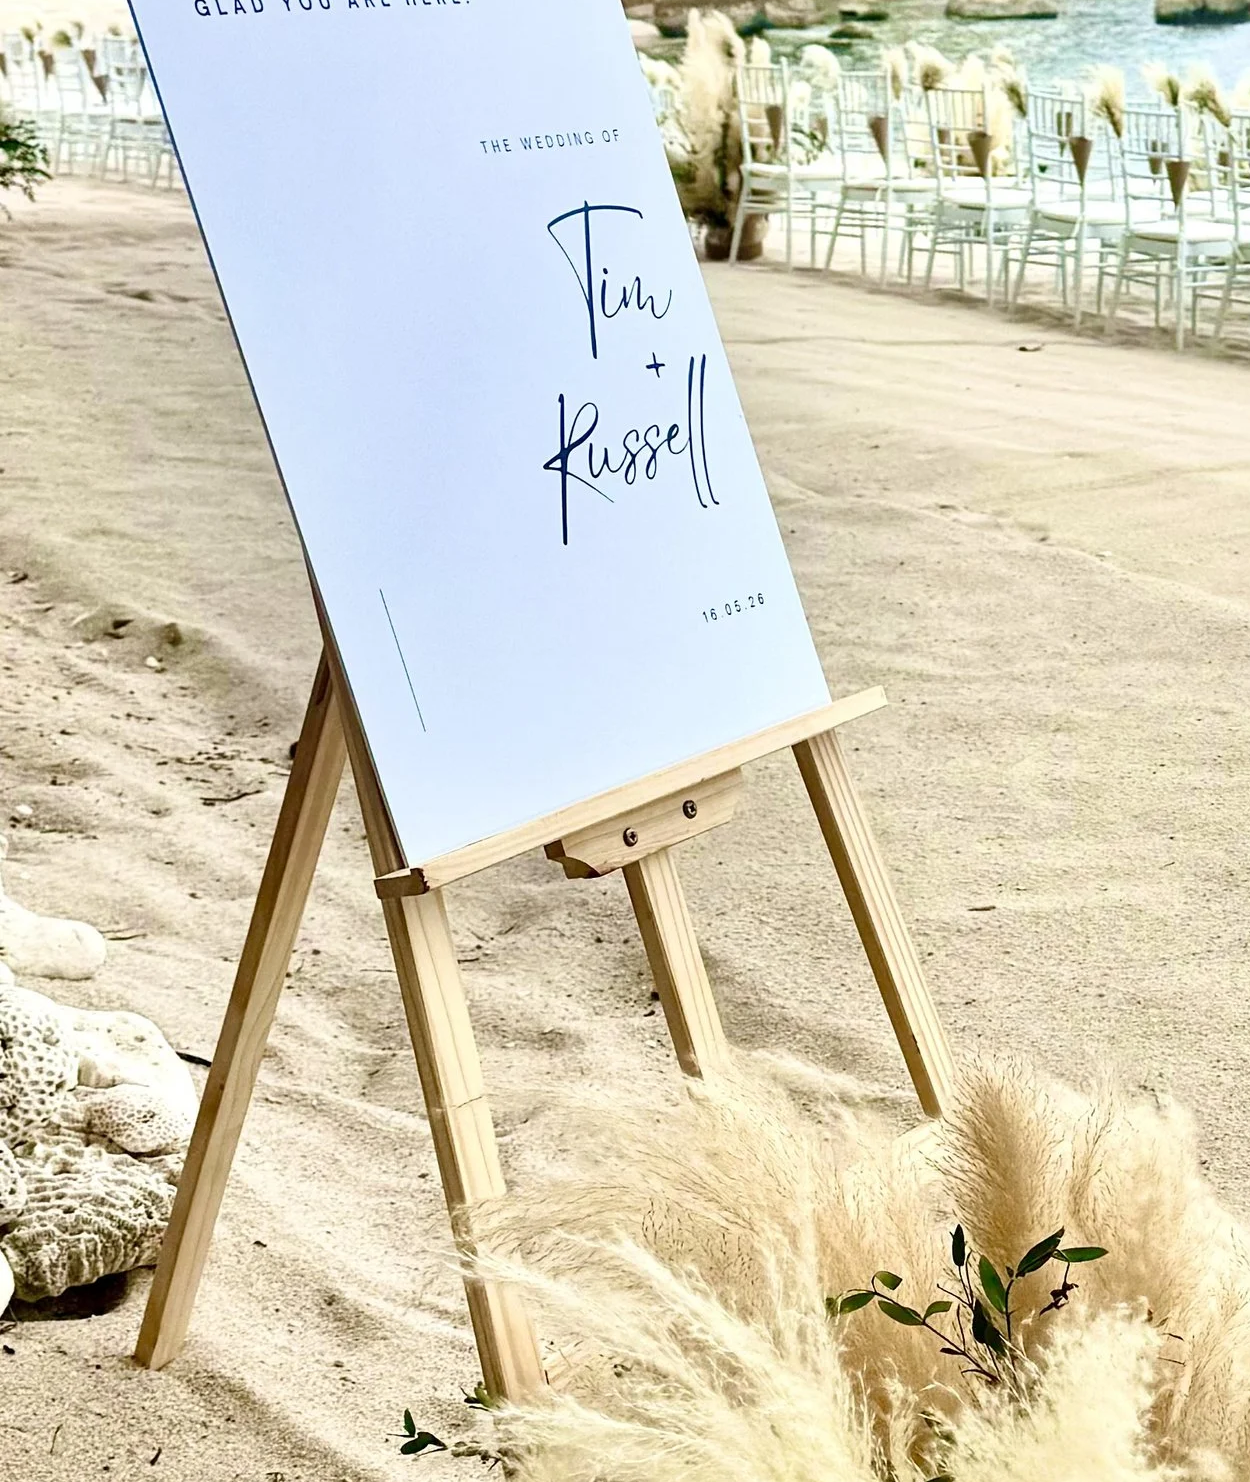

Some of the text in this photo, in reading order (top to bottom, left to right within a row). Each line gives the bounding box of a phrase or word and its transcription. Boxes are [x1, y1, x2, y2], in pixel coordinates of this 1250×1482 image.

[479, 128, 620, 155] THE WEDDING OF
[546, 199, 673, 360] Tim
[645, 351, 666, 379] +
[542, 353, 720, 547] Russell
[701, 592, 765, 624] 16.05.26
